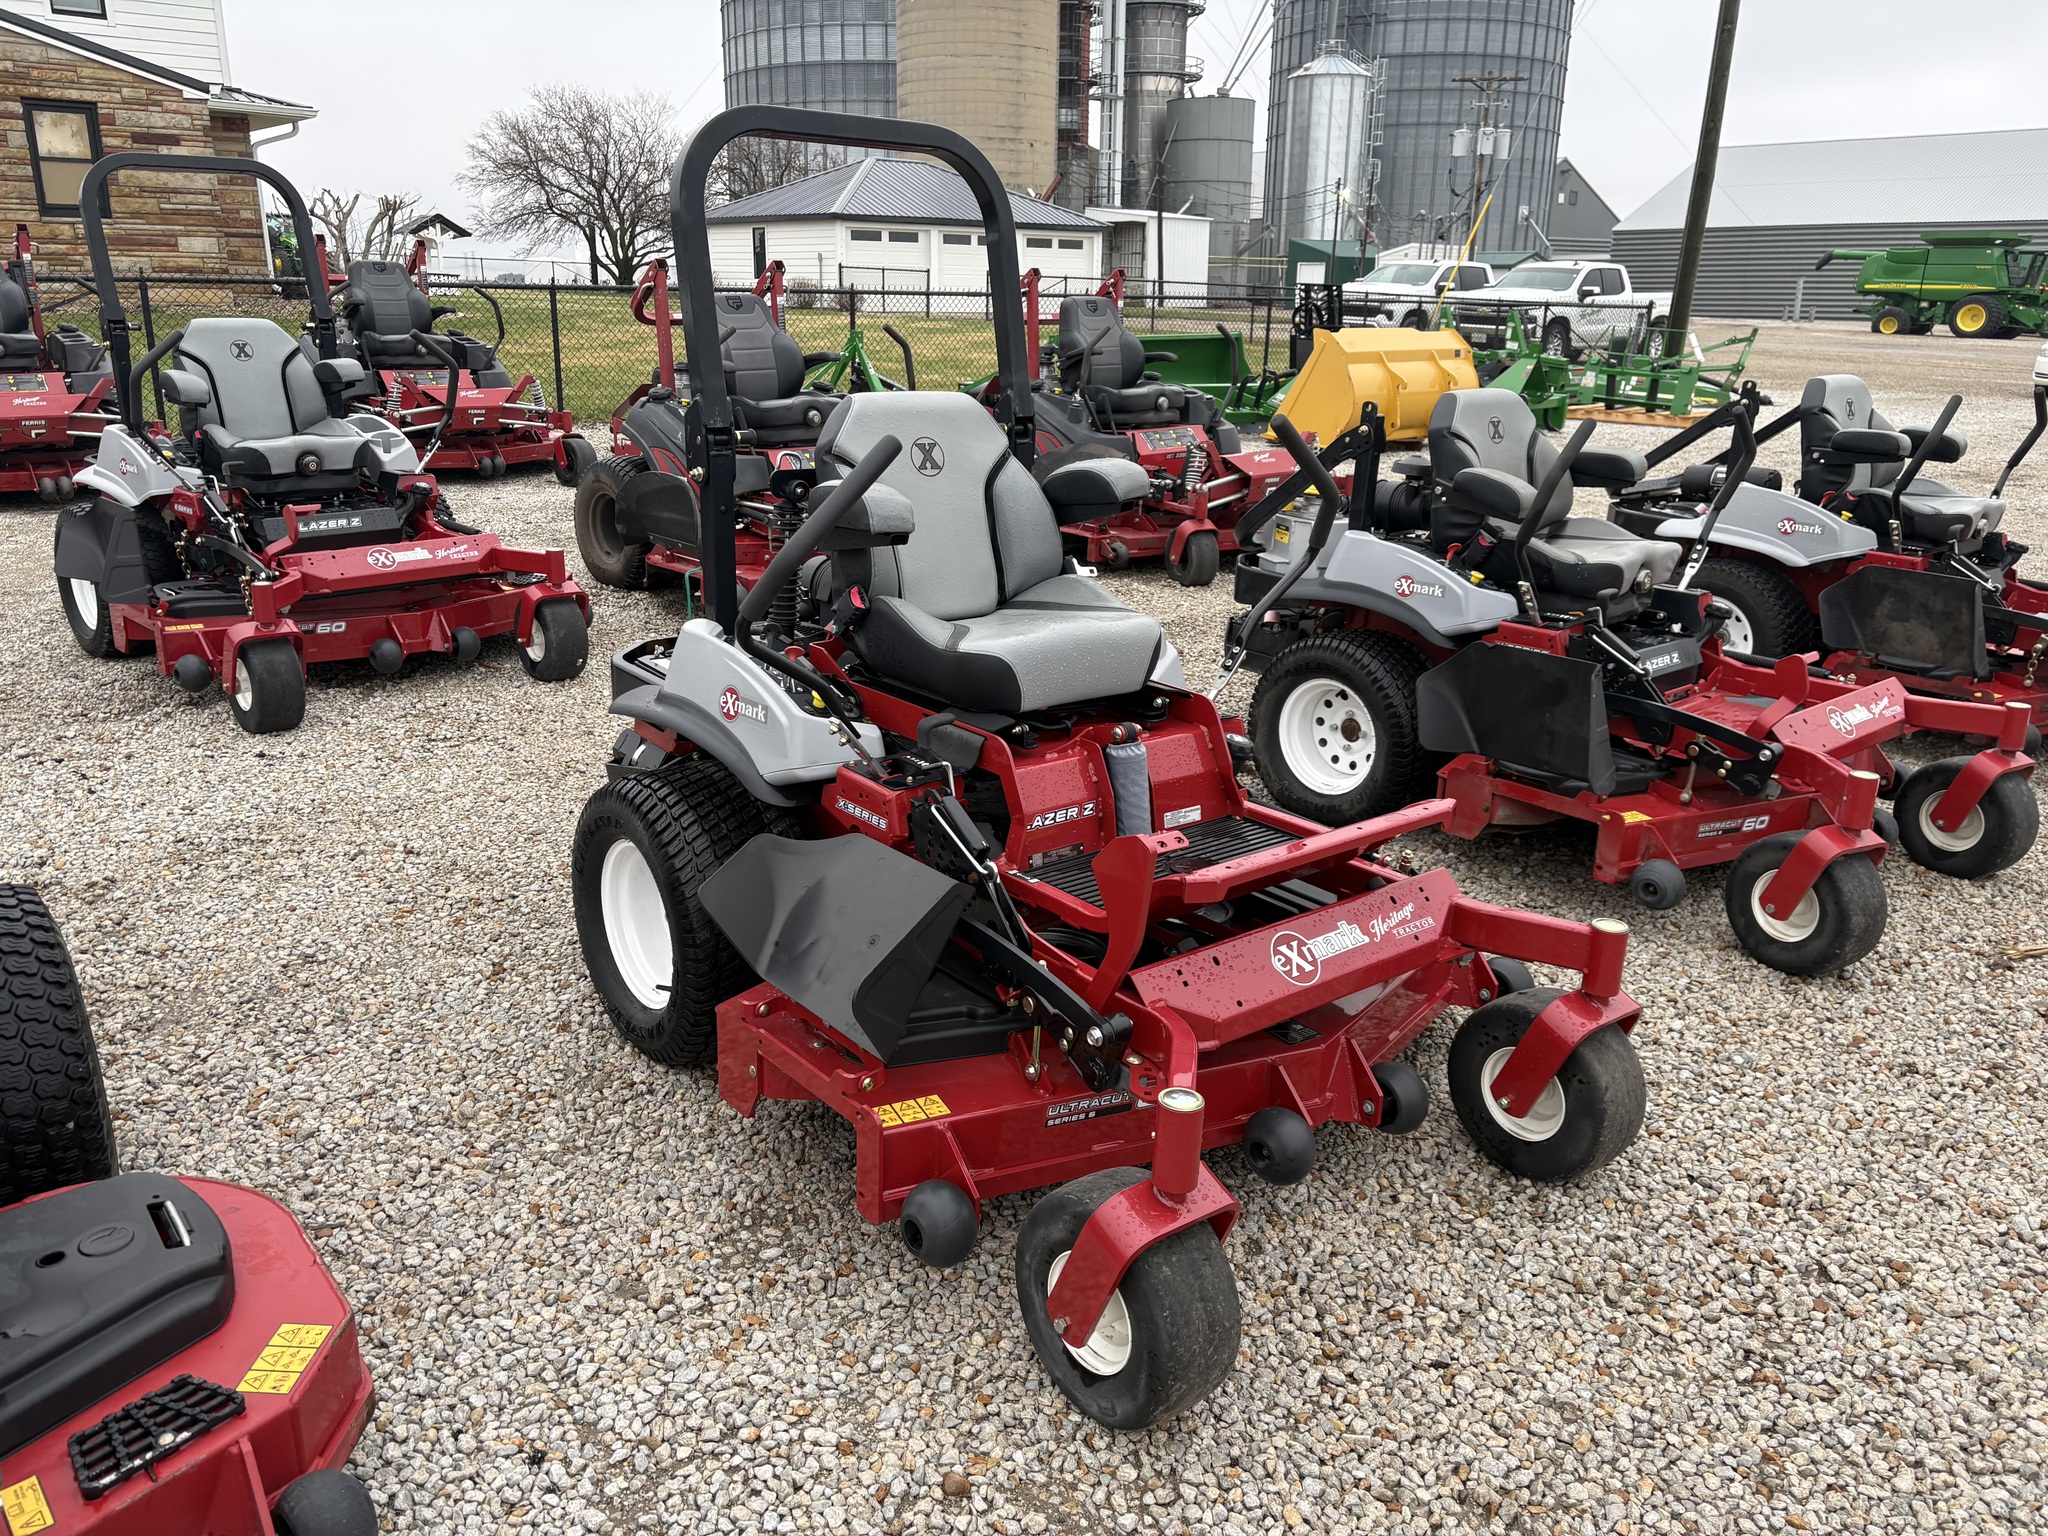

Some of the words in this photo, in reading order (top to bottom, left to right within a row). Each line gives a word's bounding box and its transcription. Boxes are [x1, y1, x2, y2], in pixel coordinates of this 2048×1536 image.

[914, 441, 943, 471] X
[299, 518, 349, 532] LAZER
[350, 516, 362, 527] Z
[1777, 519, 1823, 535] eXmark
[434, 544, 469, 560] Heritage
[1394, 577, 1443, 597] eXmark
[316, 622, 347, 634] 60
[1671, 652, 1680, 664] Z
[720, 691, 766, 724] eXmark
[837, 799, 887, 830] X-SERIES
[1027, 806, 1079, 829] AZER
[1083, 803, 1095, 817] Z
[1699, 819, 1741, 831] ULTRACUT
[1742, 815, 1770, 831] 60
[1368, 902, 1415, 942] Heritage
[1393, 917, 1435, 938] TRACTOR
[1272, 920, 1370, 978] eXmark
[1047, 1113, 1086, 1127] SERIES
[1088, 1111, 1097, 1119] 6
